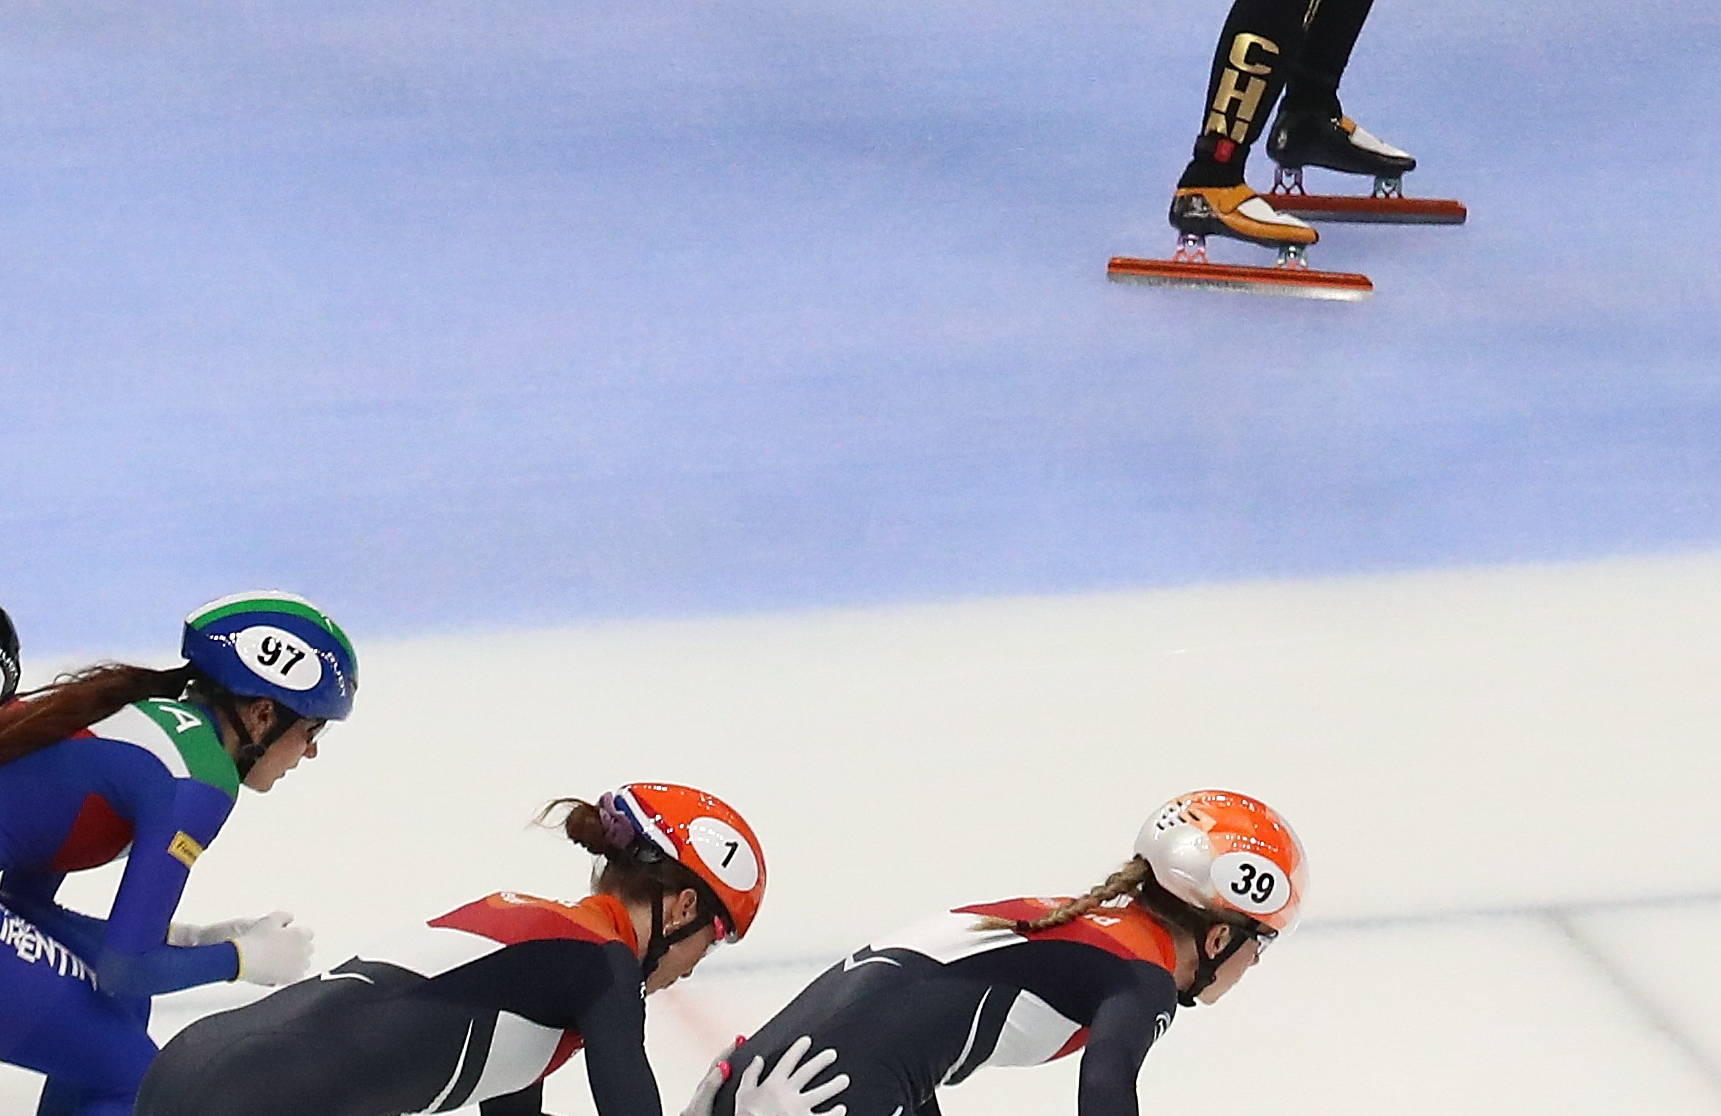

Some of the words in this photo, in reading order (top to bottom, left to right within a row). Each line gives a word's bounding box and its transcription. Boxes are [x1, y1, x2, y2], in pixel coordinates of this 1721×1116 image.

[257, 636, 306, 676] 97
[721, 841, 739, 868] 1
[1231, 863, 1275, 903] 39
